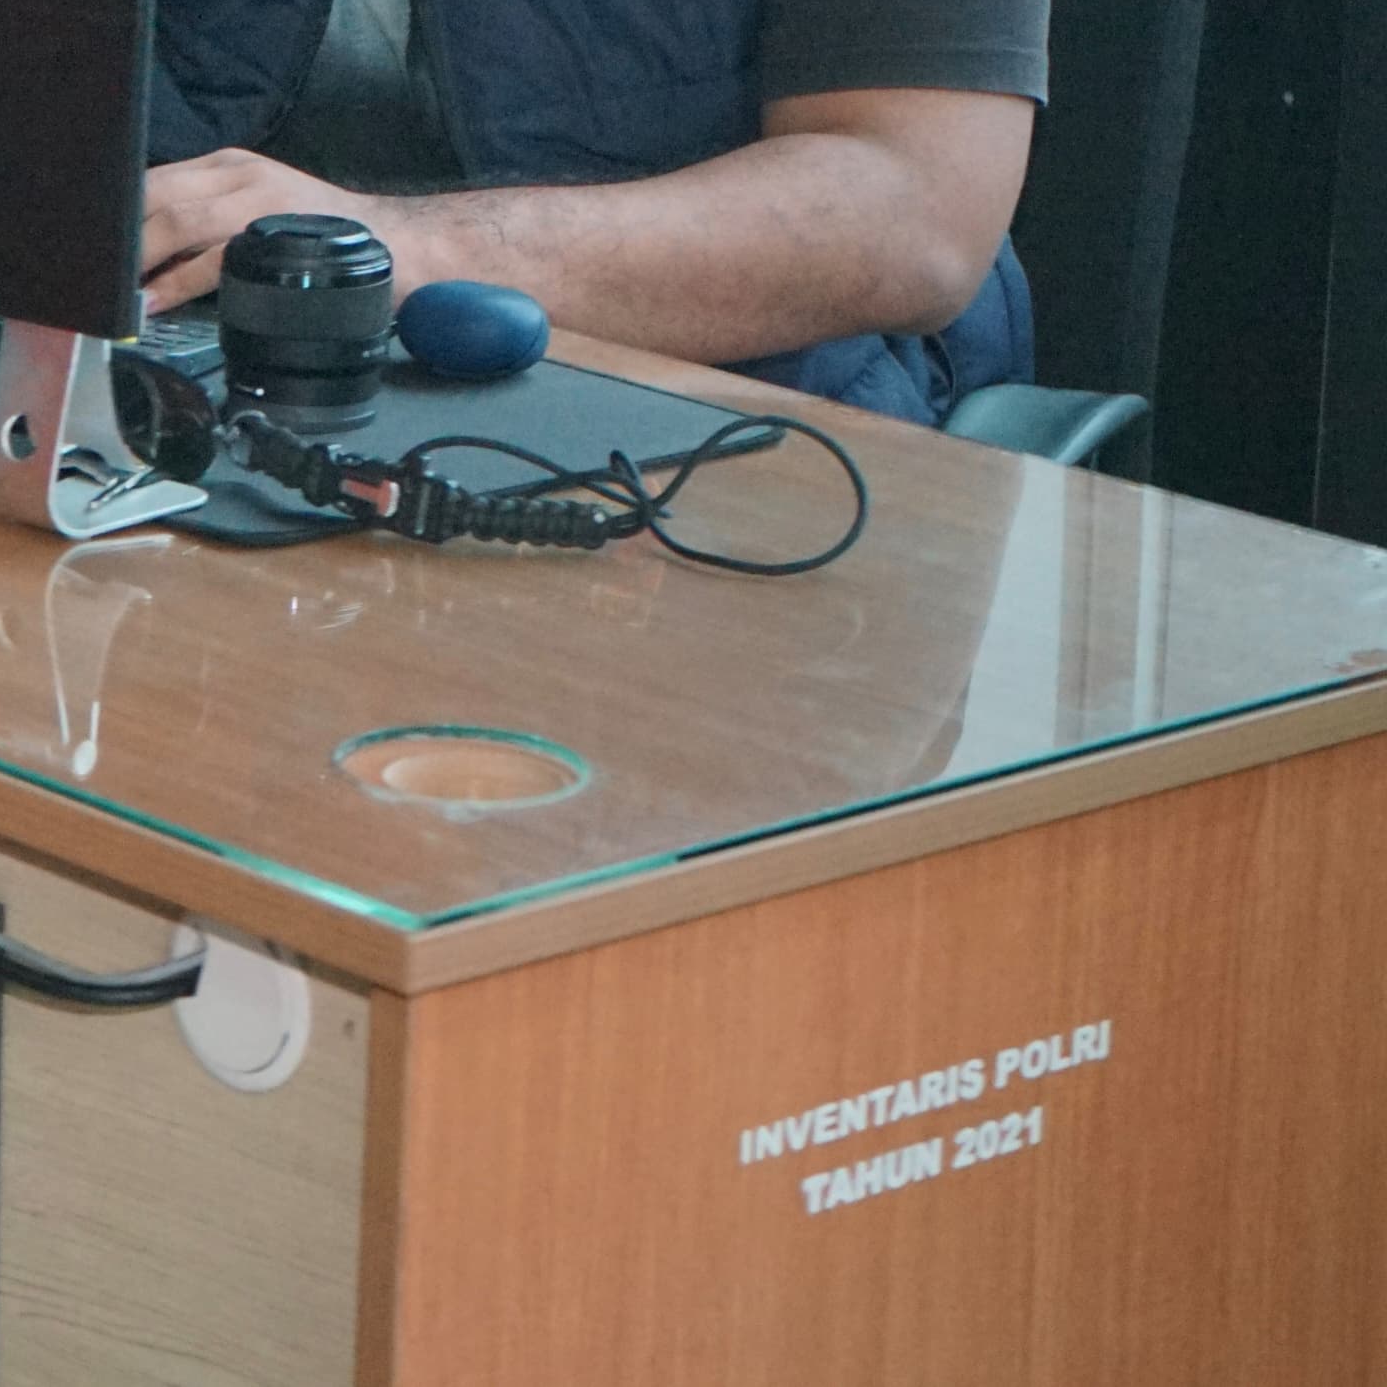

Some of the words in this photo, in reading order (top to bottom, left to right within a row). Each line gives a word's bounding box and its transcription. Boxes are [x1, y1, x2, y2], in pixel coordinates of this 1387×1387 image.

[739, 1058, 986, 1166] INVENTARIS
[993, 1020, 1112, 1090] POLRI
[800, 1136, 944, 1215] TAHUN
[950, 1105, 1045, 1169] 2021
